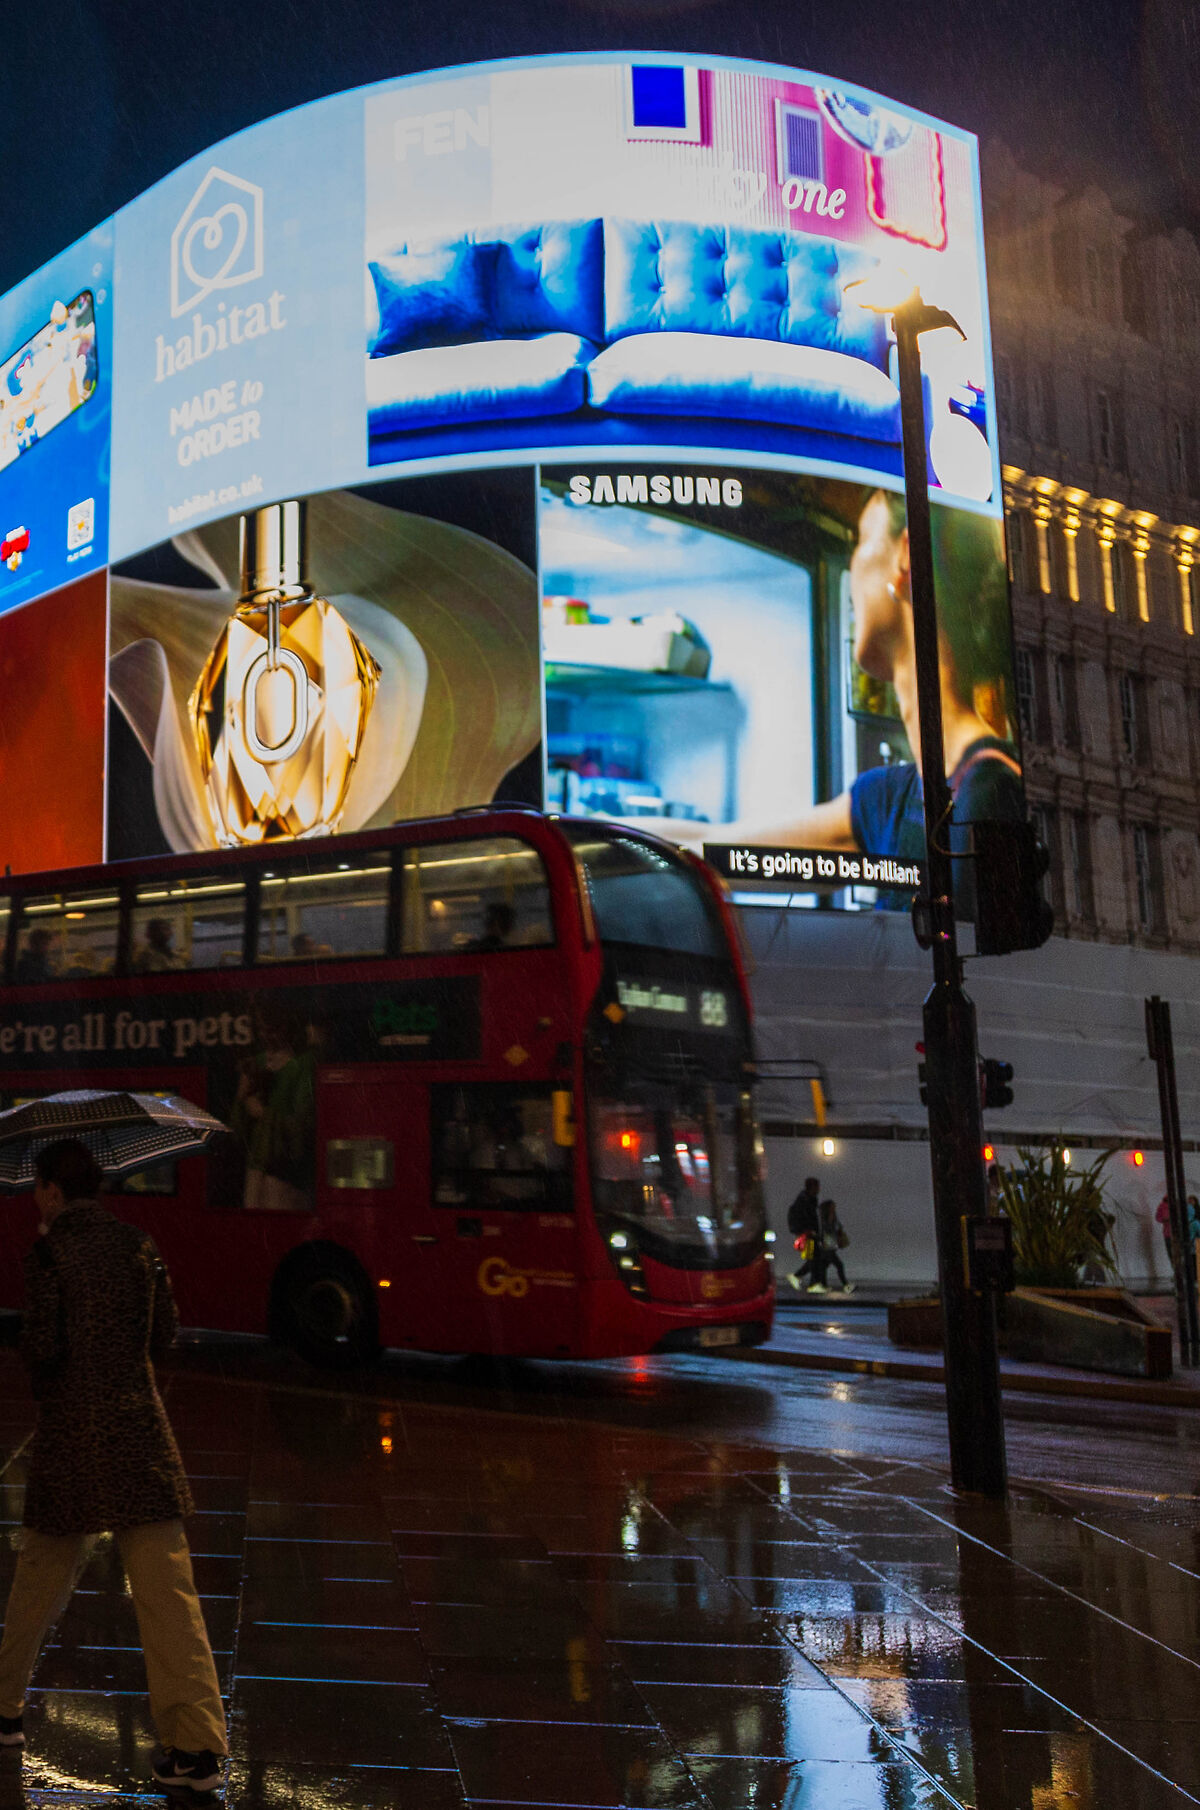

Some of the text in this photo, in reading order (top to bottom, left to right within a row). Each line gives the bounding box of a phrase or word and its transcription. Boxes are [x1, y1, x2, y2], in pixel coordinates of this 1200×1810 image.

[781, 177, 846, 220] one
[155, 290, 287, 384] habitat
[170, 380, 237, 436] MADE
[177, 409, 261, 467] ORDER
[569, 475, 743, 508] SAMSUNG
[730, 850, 921, 886] It's going to be brilliant
[62, 1013, 106, 1051] all
[114, 1011, 165, 1050] for
[173, 1011, 253, 1058] pets
[477, 1255, 529, 1298] Go
